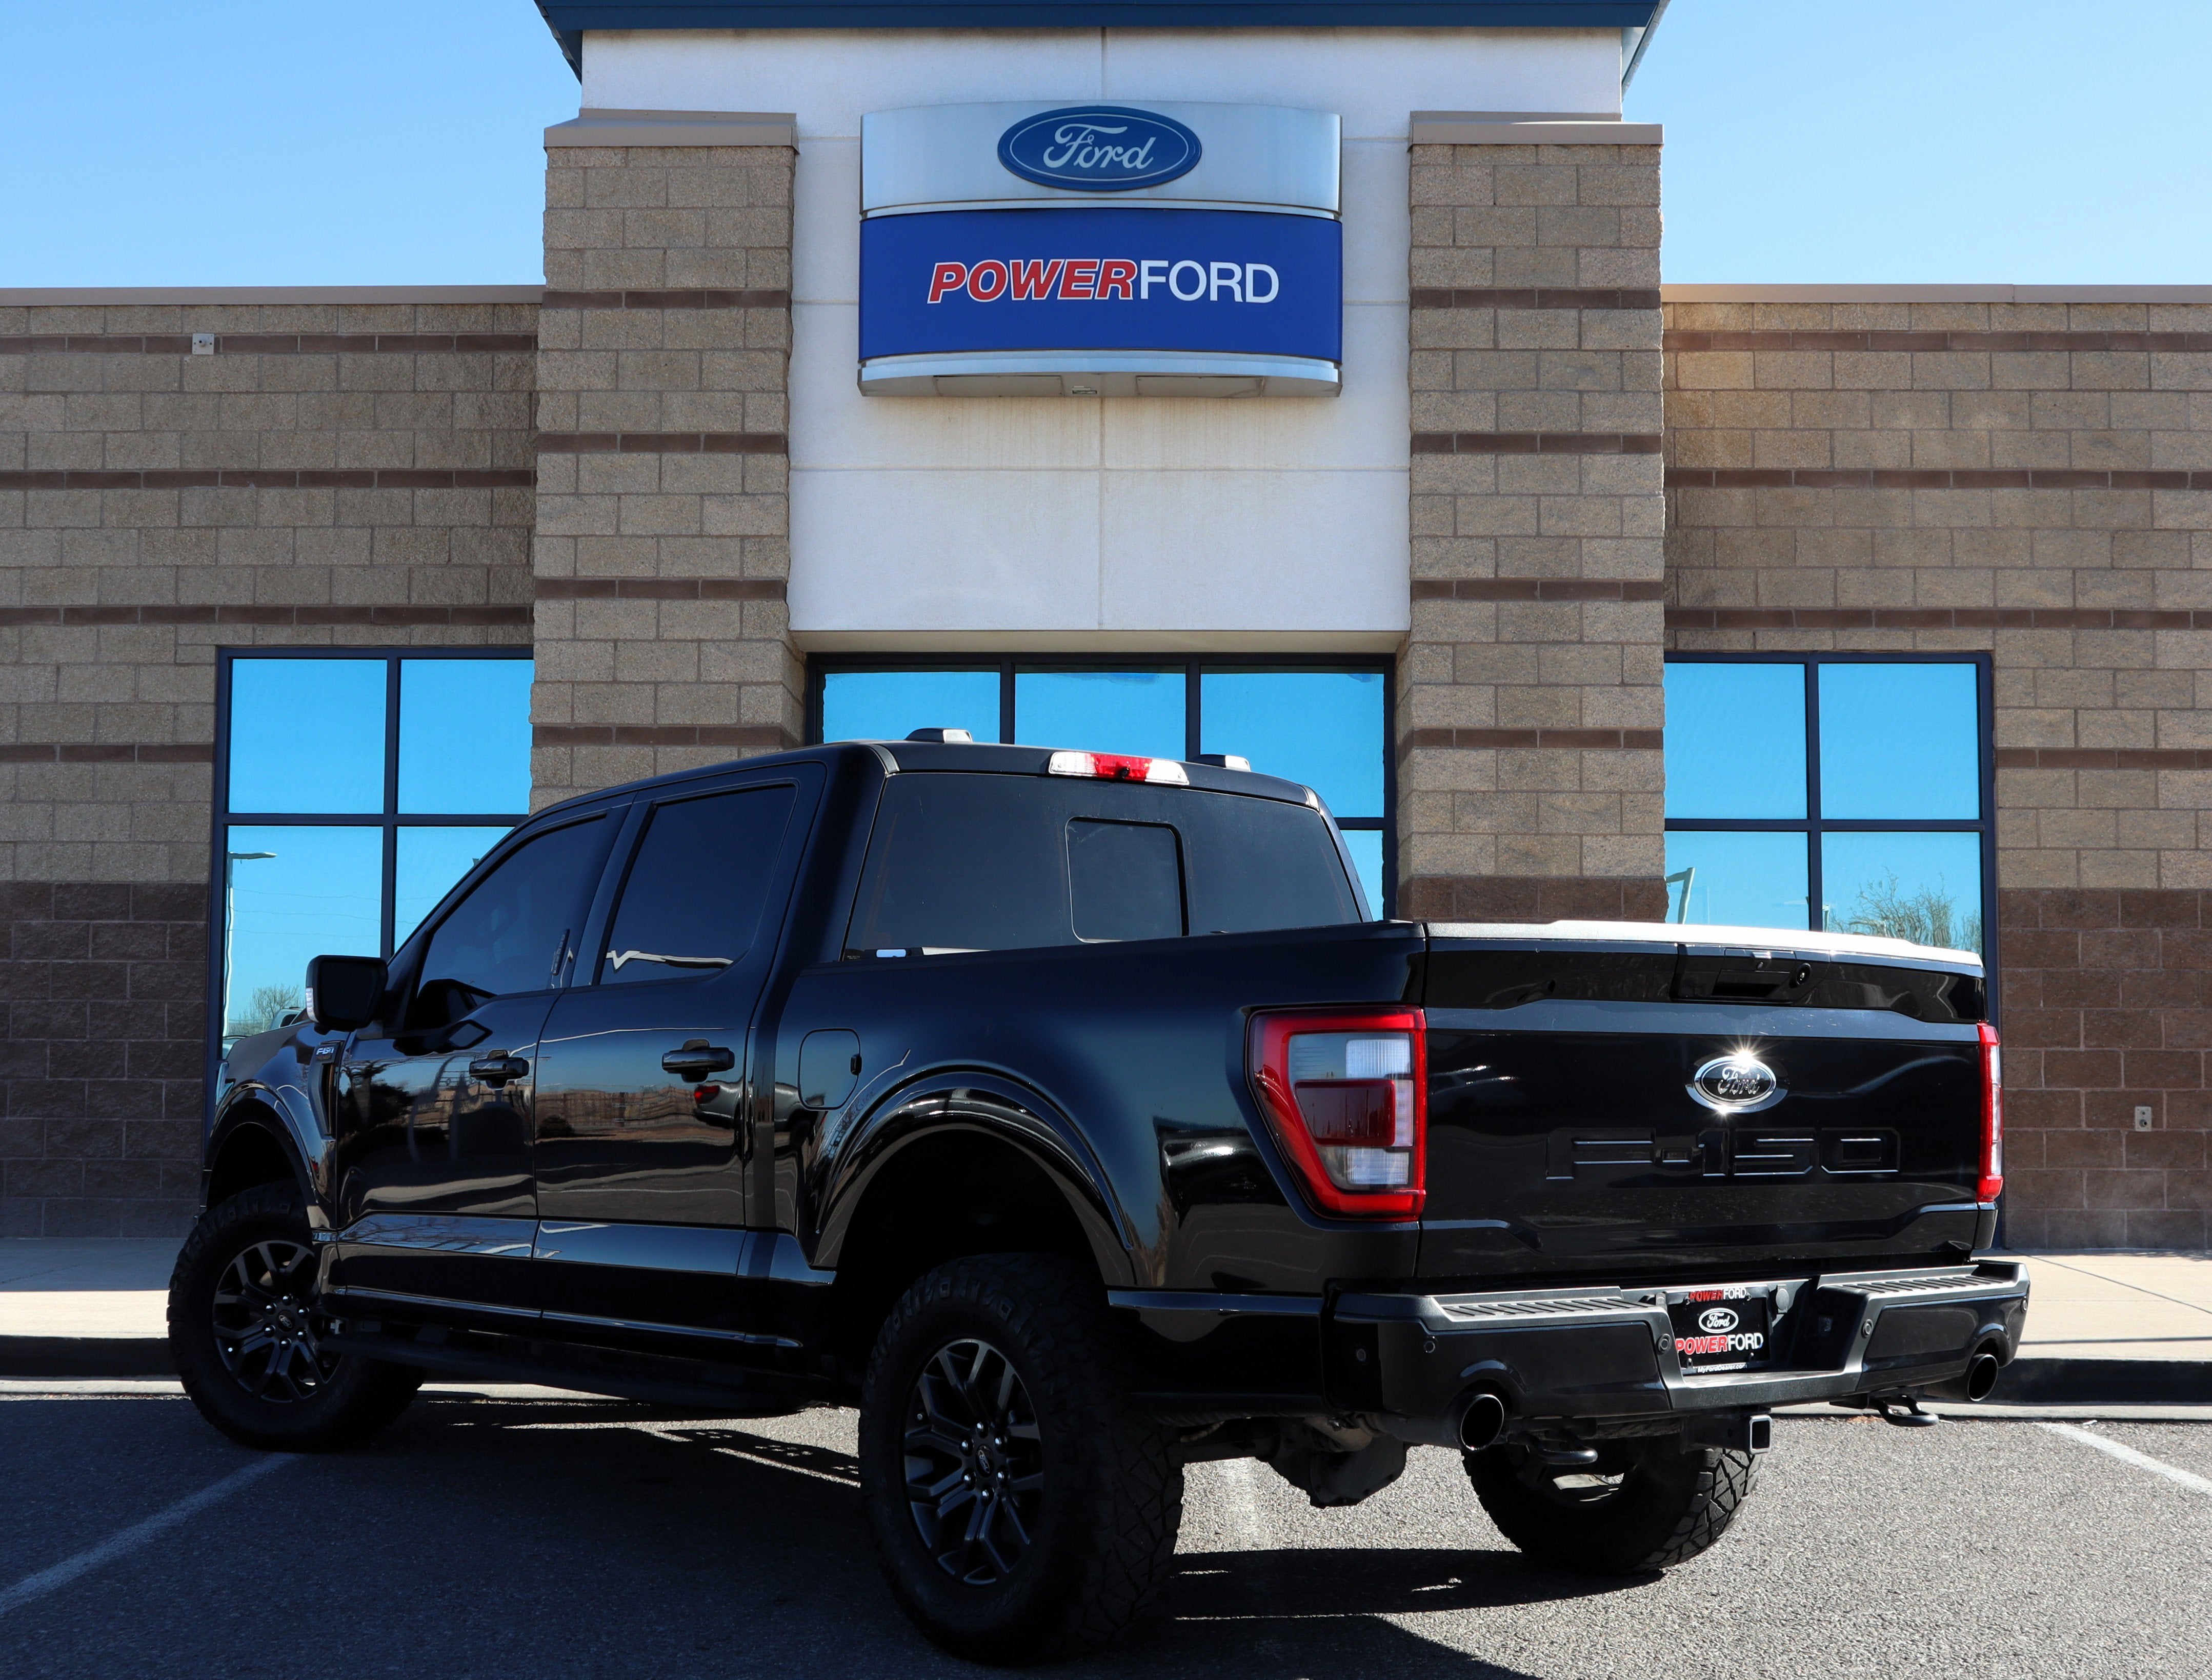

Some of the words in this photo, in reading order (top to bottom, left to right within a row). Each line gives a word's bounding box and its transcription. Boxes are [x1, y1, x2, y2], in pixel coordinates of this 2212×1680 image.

[1043, 123, 1156, 169] Ford
[1718, 1066, 1760, 1095] Ford
[1545, 1128, 1900, 1180] F-150
[1706, 1312, 1731, 1328] Ford
